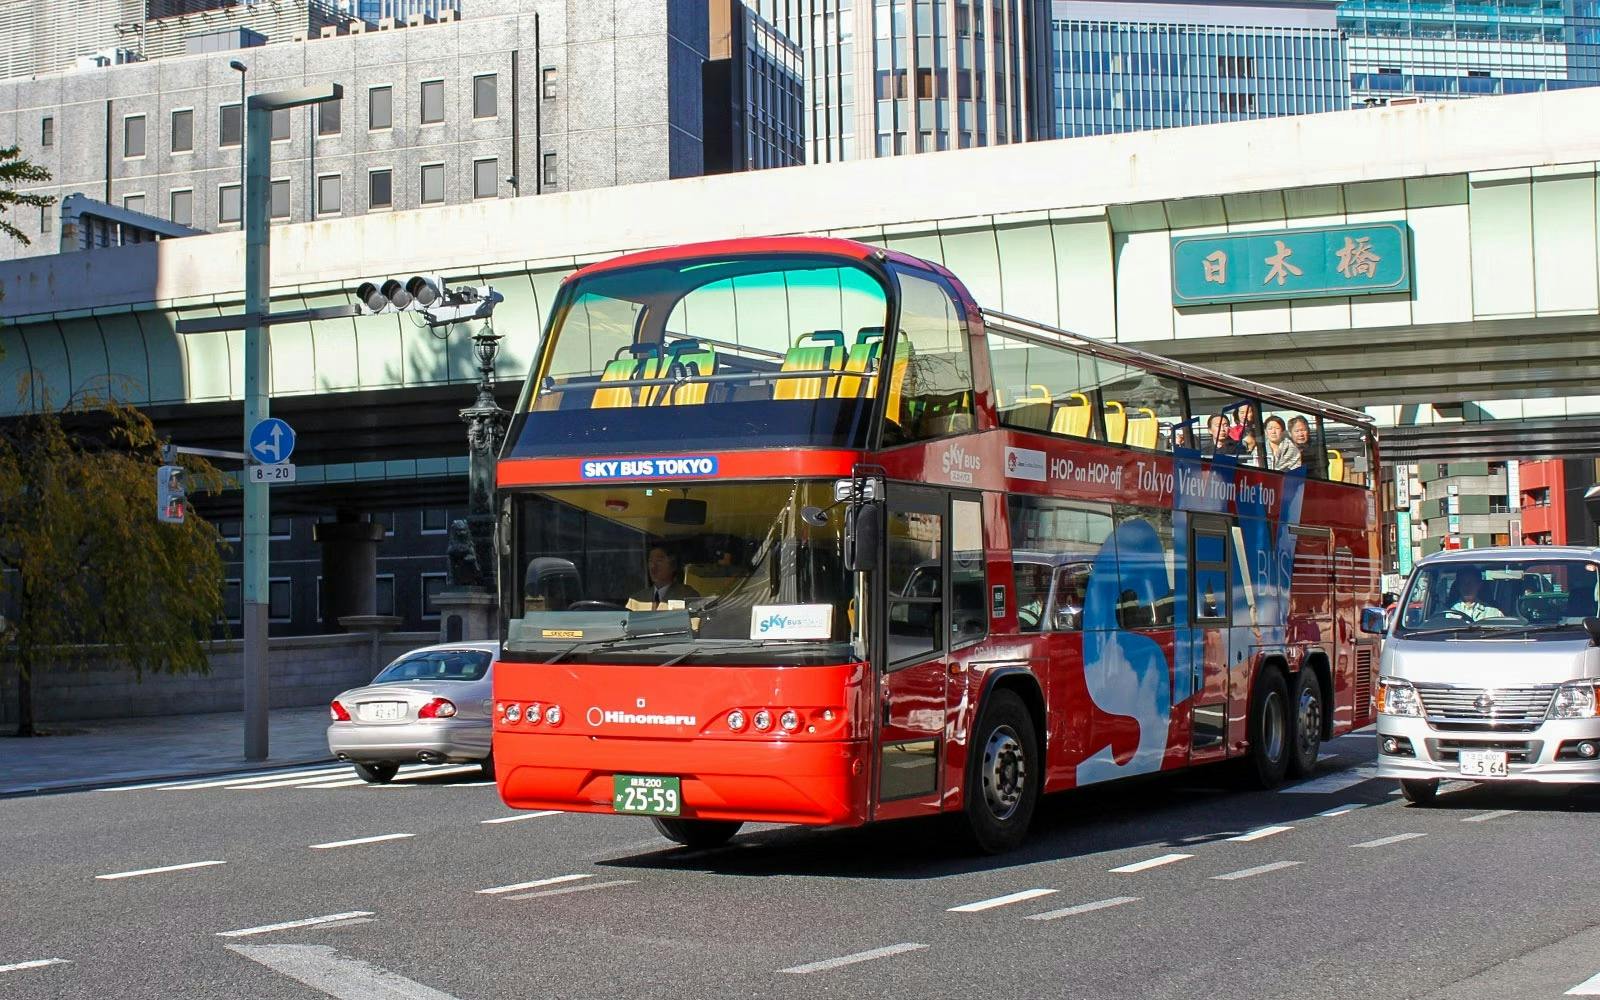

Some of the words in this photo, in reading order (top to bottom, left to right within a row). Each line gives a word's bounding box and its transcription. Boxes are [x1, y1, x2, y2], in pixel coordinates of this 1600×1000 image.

[1202, 236, 1381, 286] 日本橋
[585, 461, 618, 477] SKY
[620, 460, 653, 476] BUS
[656, 458, 713, 475] TOKYO
[943, 443, 965, 474] SKY
[964, 454, 981, 470] BUS
[1051, 457, 1073, 480] HOP
[1075, 466, 1086, 481] on
[1088, 461, 1108, 484] HOP
[1110, 465, 1122, 490] off
[1137, 461, 1174, 501] Tokyo
[1178, 467, 1207, 498] View
[1210, 472, 1236, 501] from
[1240, 475, 1256, 502] the
[1259, 482, 1275, 514] top
[760, 614, 787, 632] SKY
[604, 710, 696, 726] Hinomaru
[624, 787, 677, 813] 25-59
